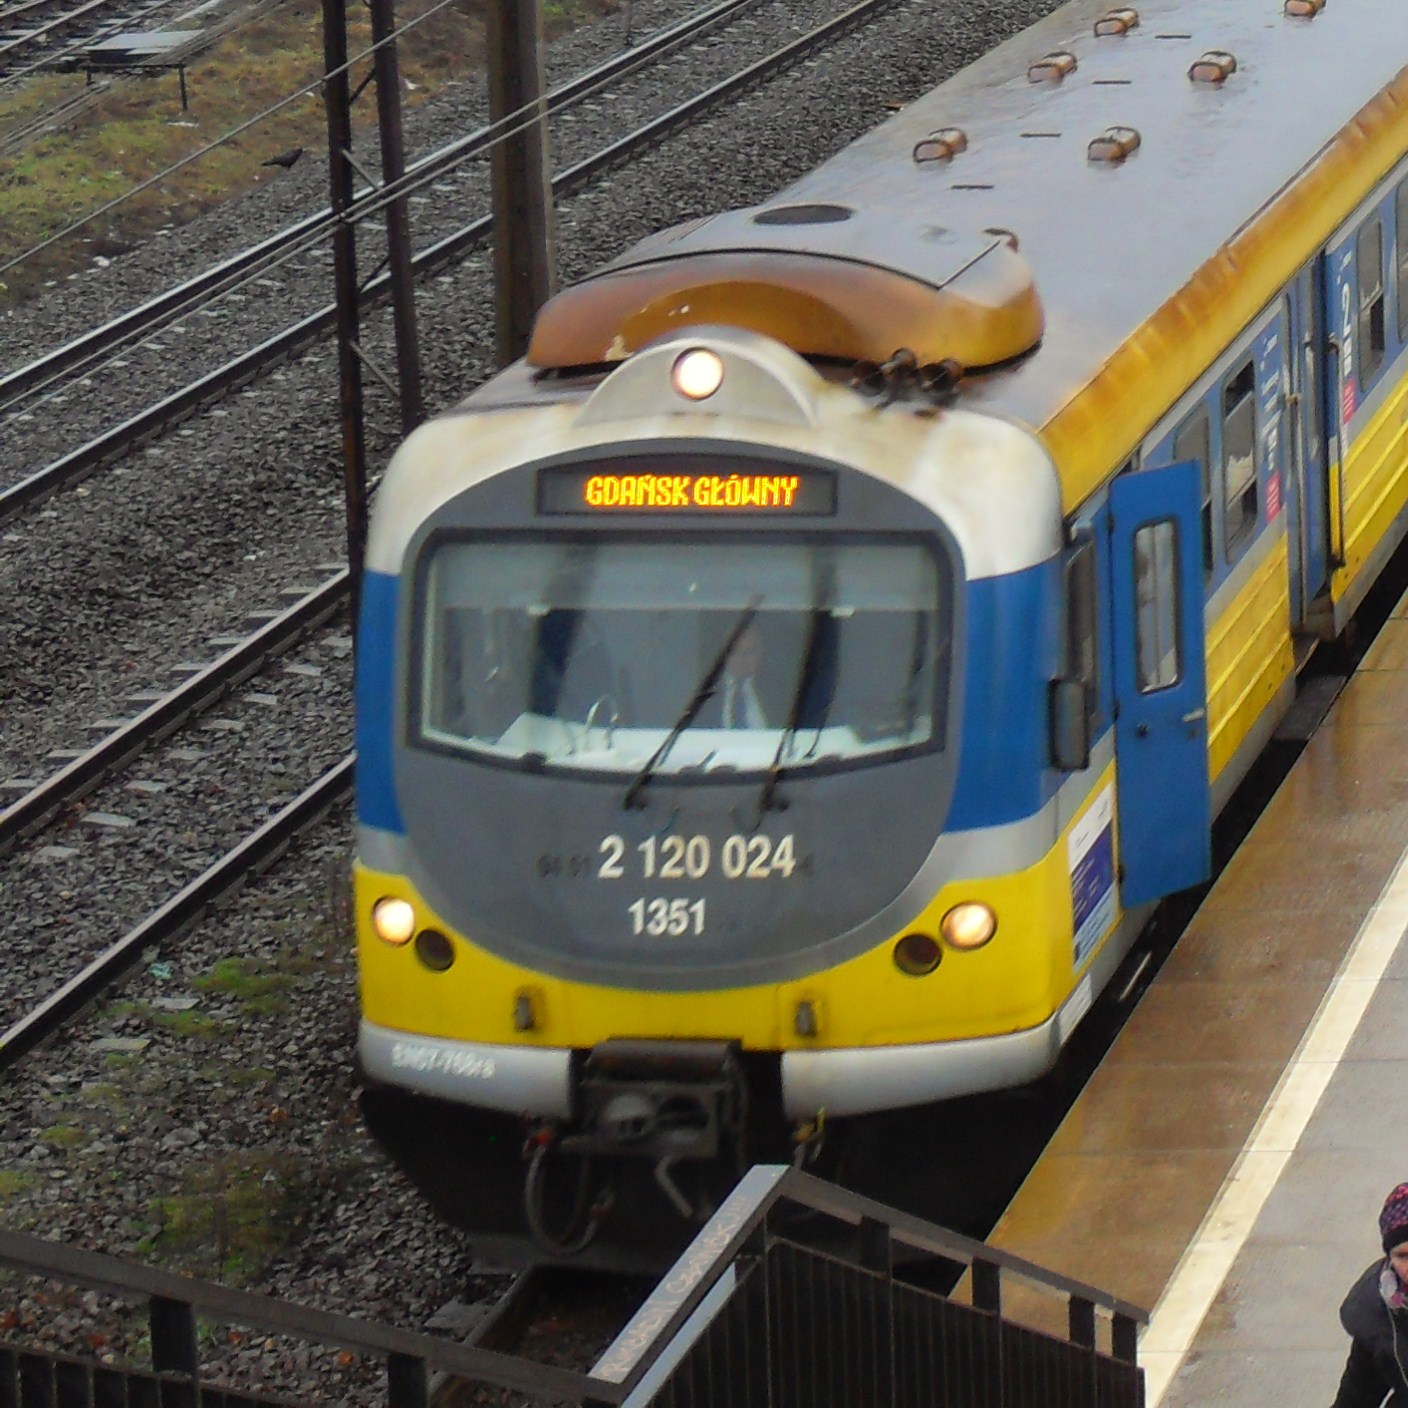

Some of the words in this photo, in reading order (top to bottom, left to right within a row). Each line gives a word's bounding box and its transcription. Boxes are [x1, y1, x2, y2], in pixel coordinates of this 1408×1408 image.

[586, 474, 691, 506] GDAŃSK
[693, 474, 799, 507] GŁÓWNY
[598, 834, 625, 879] 2
[637, 834, 711, 879] 120
[721, 833, 796, 879] 024
[627, 897, 706, 936] 1351
